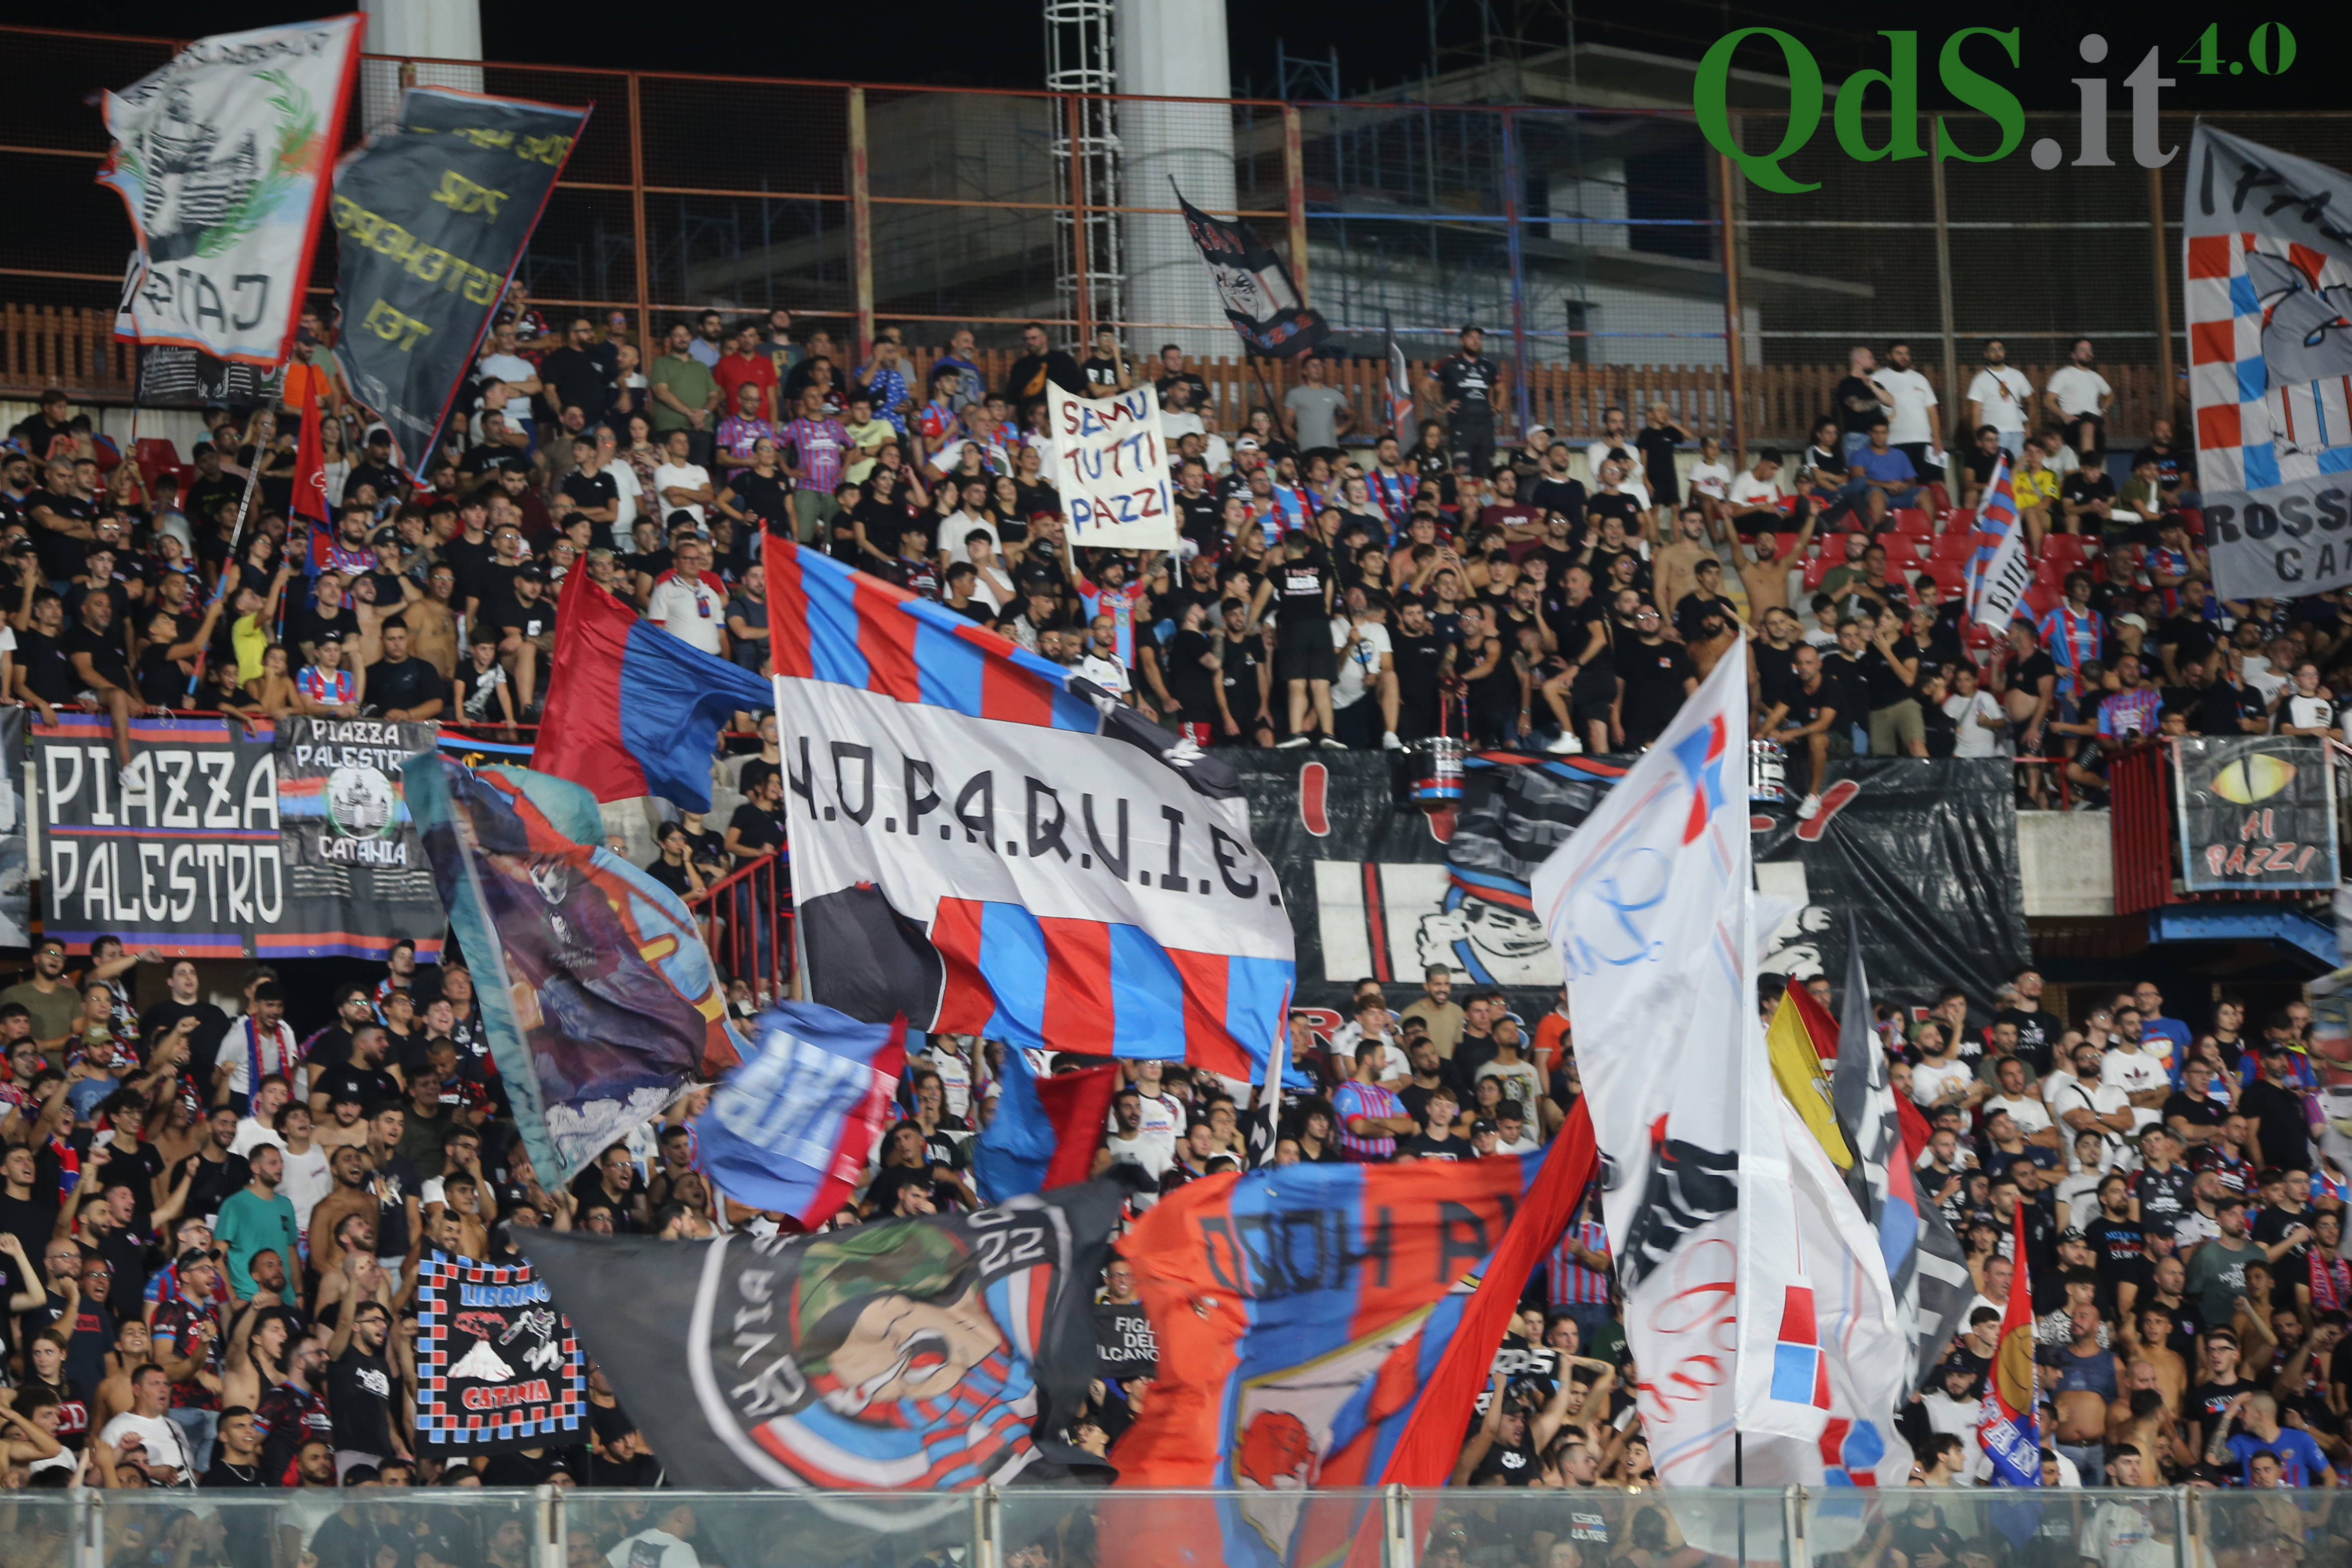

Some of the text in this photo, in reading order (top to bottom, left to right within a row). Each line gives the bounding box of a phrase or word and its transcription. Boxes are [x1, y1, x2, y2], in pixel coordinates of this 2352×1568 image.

[1063, 391, 1146, 437] SEMU
[1064, 431, 1156, 485] TUTTI
[1071, 479, 1168, 536] PAZZI
[2203, 489, 2352, 547] ROSS
[311, 719, 400, 746] PIAZZA
[45, 745, 280, 830] PIAZZA
[2241, 807, 2274, 841] AI
[318, 836, 407, 865] CATANIA
[2205, 842, 2316, 876] PAZZI
[50, 840, 283, 924] PALESTRO
[978, 1227, 1045, 1277] 22
[459, 1278, 552, 1308] LIBRINO
[1115, 1316, 1159, 1337] FIGL
[1124, 1333, 1160, 1349] DEL
[461, 1379, 552, 1411] CATANIA
